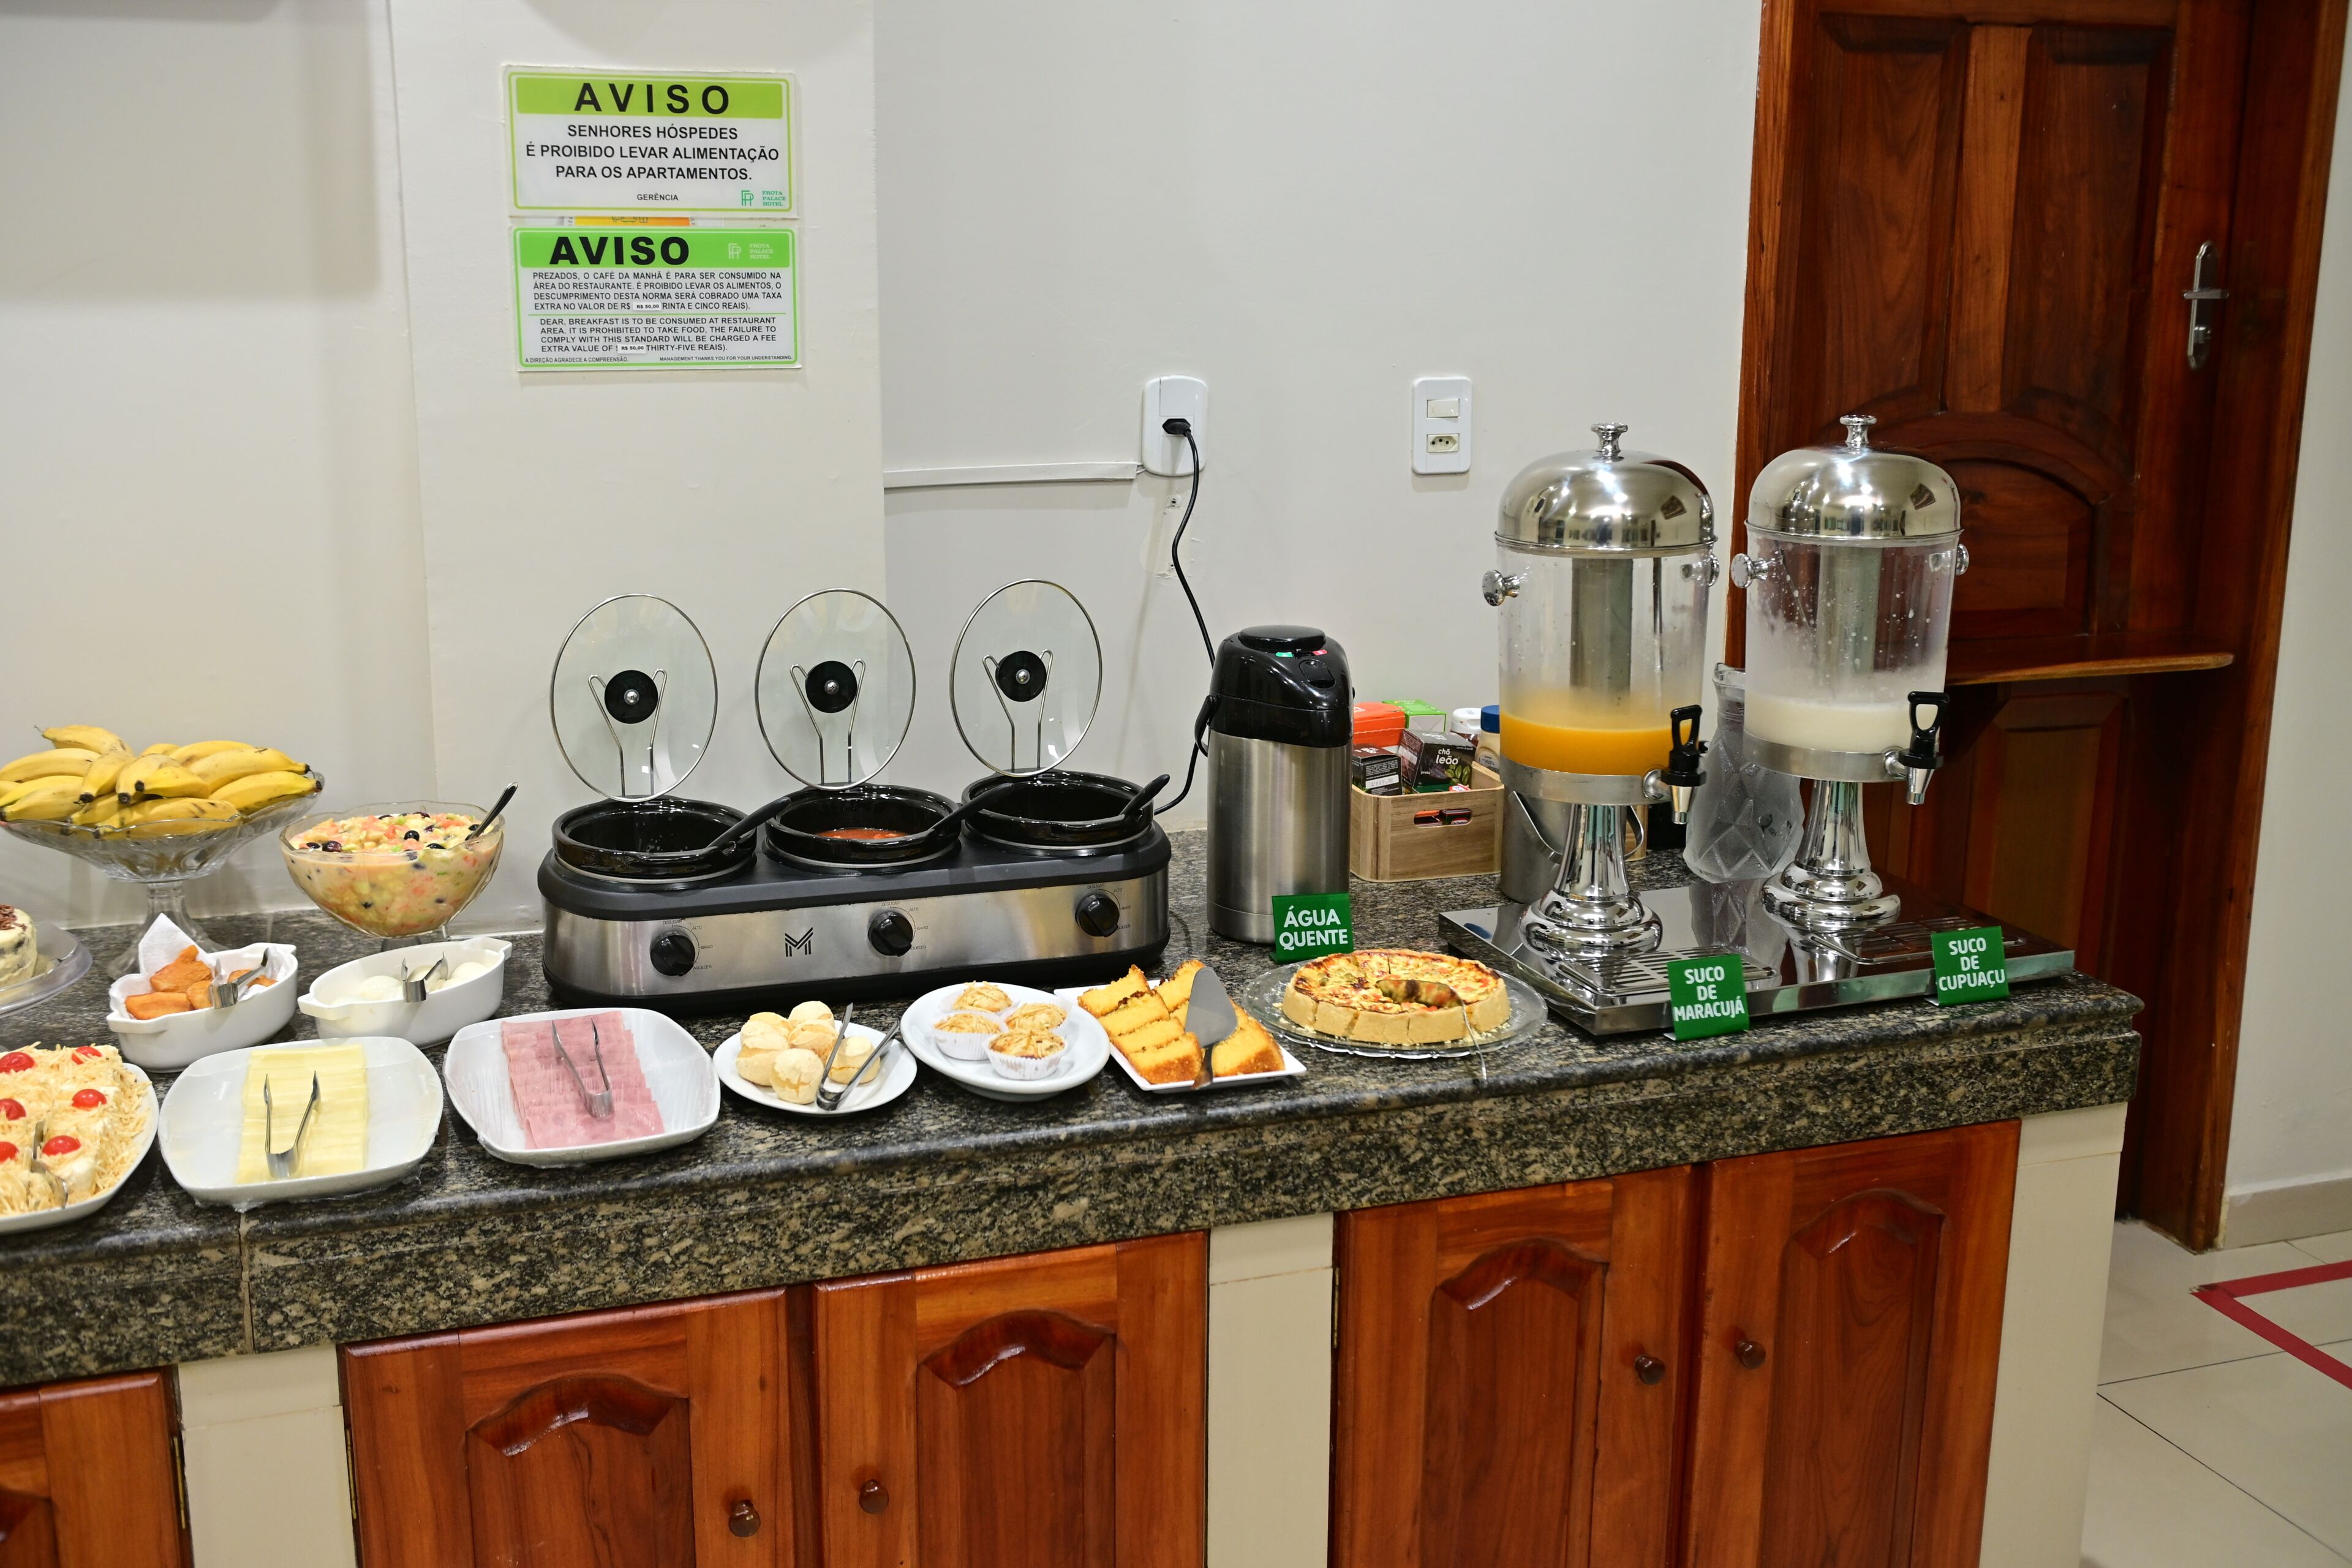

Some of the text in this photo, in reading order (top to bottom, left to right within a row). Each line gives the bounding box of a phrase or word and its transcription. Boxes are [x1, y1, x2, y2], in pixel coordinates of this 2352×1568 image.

[575, 83, 728, 114] AVISO
[568, 124, 737, 140] SENHORES HÓSPEDES
[526, 141, 778, 162] É PROIBIDO LEVAR ALIMENTAÇÃO
[556, 165, 751, 179] PARA OS APARTAMENTOS.
[549, 236, 688, 265] AVISO
[633, 271, 662, 279] MANHÃ
[1436, 754, 1459, 765] leão
[1284, 905, 1341, 927] ÁGUA
[1279, 929, 1348, 950] QUENTE
[1948, 937, 1986, 956] SUCO
[1960, 955, 1980, 971] DE
[1684, 966, 1725, 984] SUCO
[1939, 969, 2005, 991] CUPUAÇU
[1696, 984, 1717, 1001] DE
[1673, 996, 1745, 1022] MARACUJÁ
